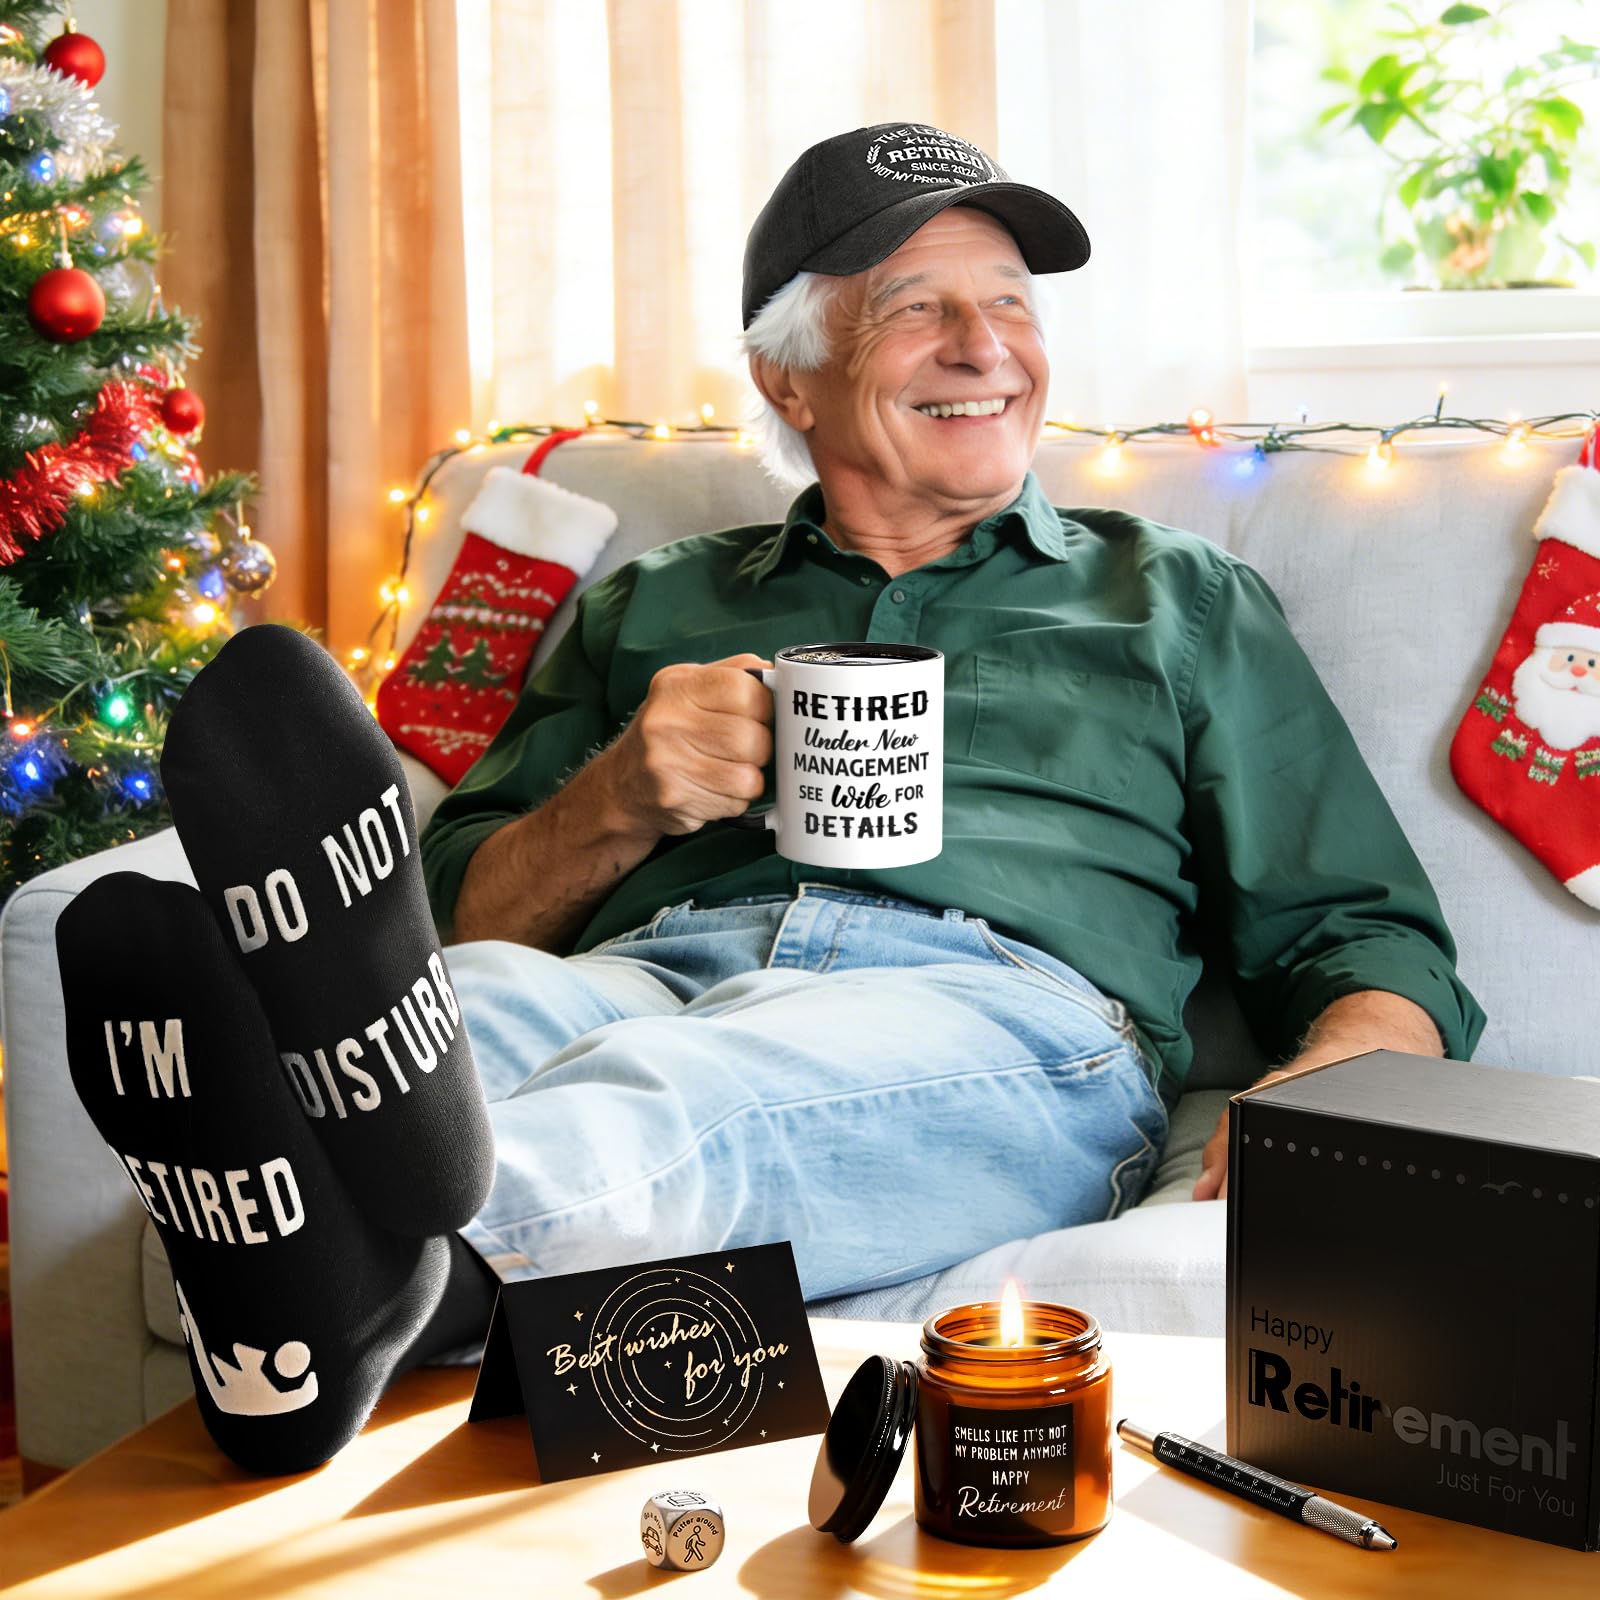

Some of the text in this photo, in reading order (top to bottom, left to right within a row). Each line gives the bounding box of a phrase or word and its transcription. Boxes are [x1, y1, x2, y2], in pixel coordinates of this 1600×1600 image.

[874, 127, 911, 144] THE
[917, 136, 951, 147] HAS
[887, 146, 984, 170] RETIRED
[911, 162, 951, 172] SINCE
[870, 162, 894, 178] NOT
[892, 172, 913, 182] MY
[792, 690, 929, 721] RETIRED
[804, 727, 919, 751] Under New
[794, 752, 929, 777] MANAGEMENT
[799, 783, 924, 809] SEE Wife FOR
[804, 812, 918, 838] DETAILS
[224, 784, 412, 954] DO NOT
[280, 951, 460, 1120] DISTURB
[104, 1018, 192, 1099] I'M
[110, 1145, 305, 1245] ETIRED
[1251, 1306, 1334, 1354] Happy
[547, 1313, 715, 1376] Best wishes
[684, 1342, 789, 1400] for you
[1249, 1348, 1576, 1481] Retirement
[954, 1425, 1067, 1443] SMELLS LIKE IT'S NOT
[955, 1443, 1067, 1461] MY PROBLEM ANYMORE
[992, 1470, 1030, 1486] HAPPY
[1436, 1463, 1575, 1518] Just For You
[958, 1486, 1067, 1518] Retirement
[672, 1517, 694, 1538] Putter
[695, 1517, 719, 1535] around
